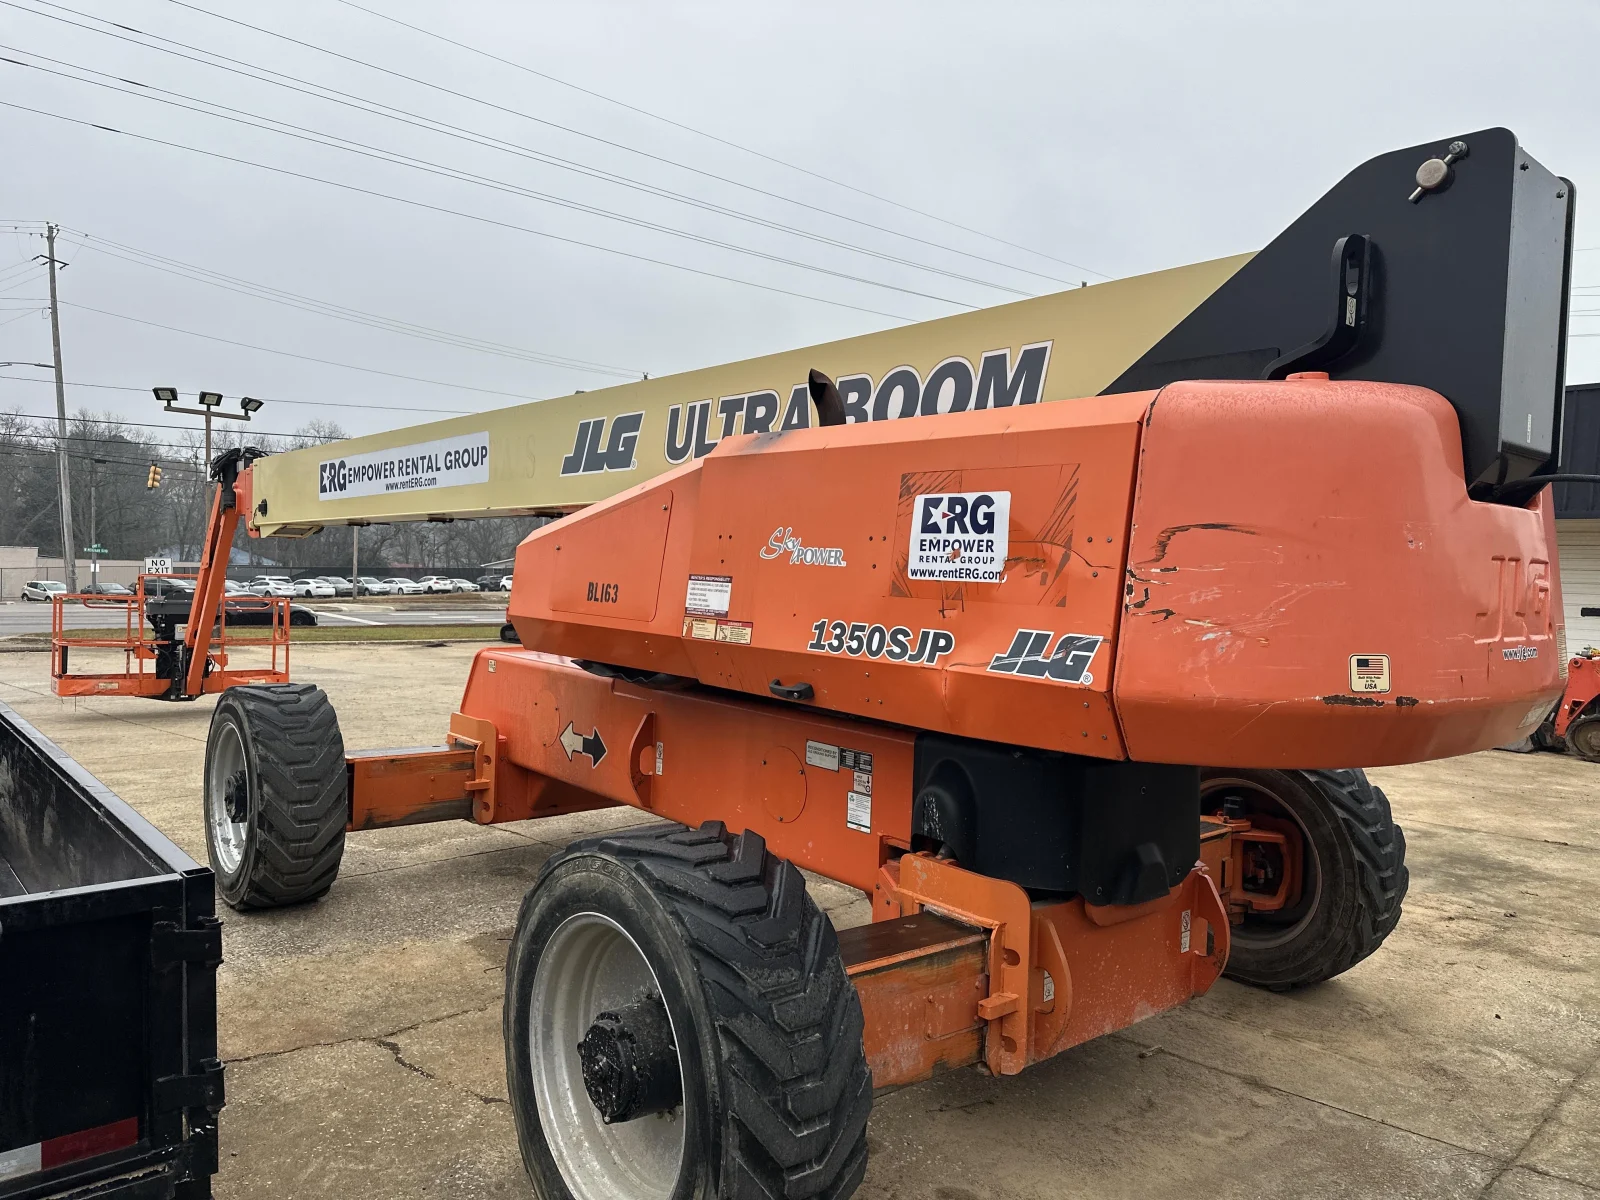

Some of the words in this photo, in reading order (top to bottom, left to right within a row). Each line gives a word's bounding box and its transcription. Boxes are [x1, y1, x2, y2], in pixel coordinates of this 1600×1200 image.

[320, 460, 347, 493] ERG
[348, 461, 396, 484] EMPOWER
[398, 453, 441, 477] RENTAL
[444, 445, 488, 471] GROUP
[385, 476, 437, 491] www.rentERG.com
[920, 494, 995, 535] ERG
[919, 538, 995, 553] EMPOWER
[151, 559, 166, 567] NO
[793, 547, 844, 567] POWER
[960, 556, 995, 565] GROUP
[807, 618, 955, 666] 1350SJP
